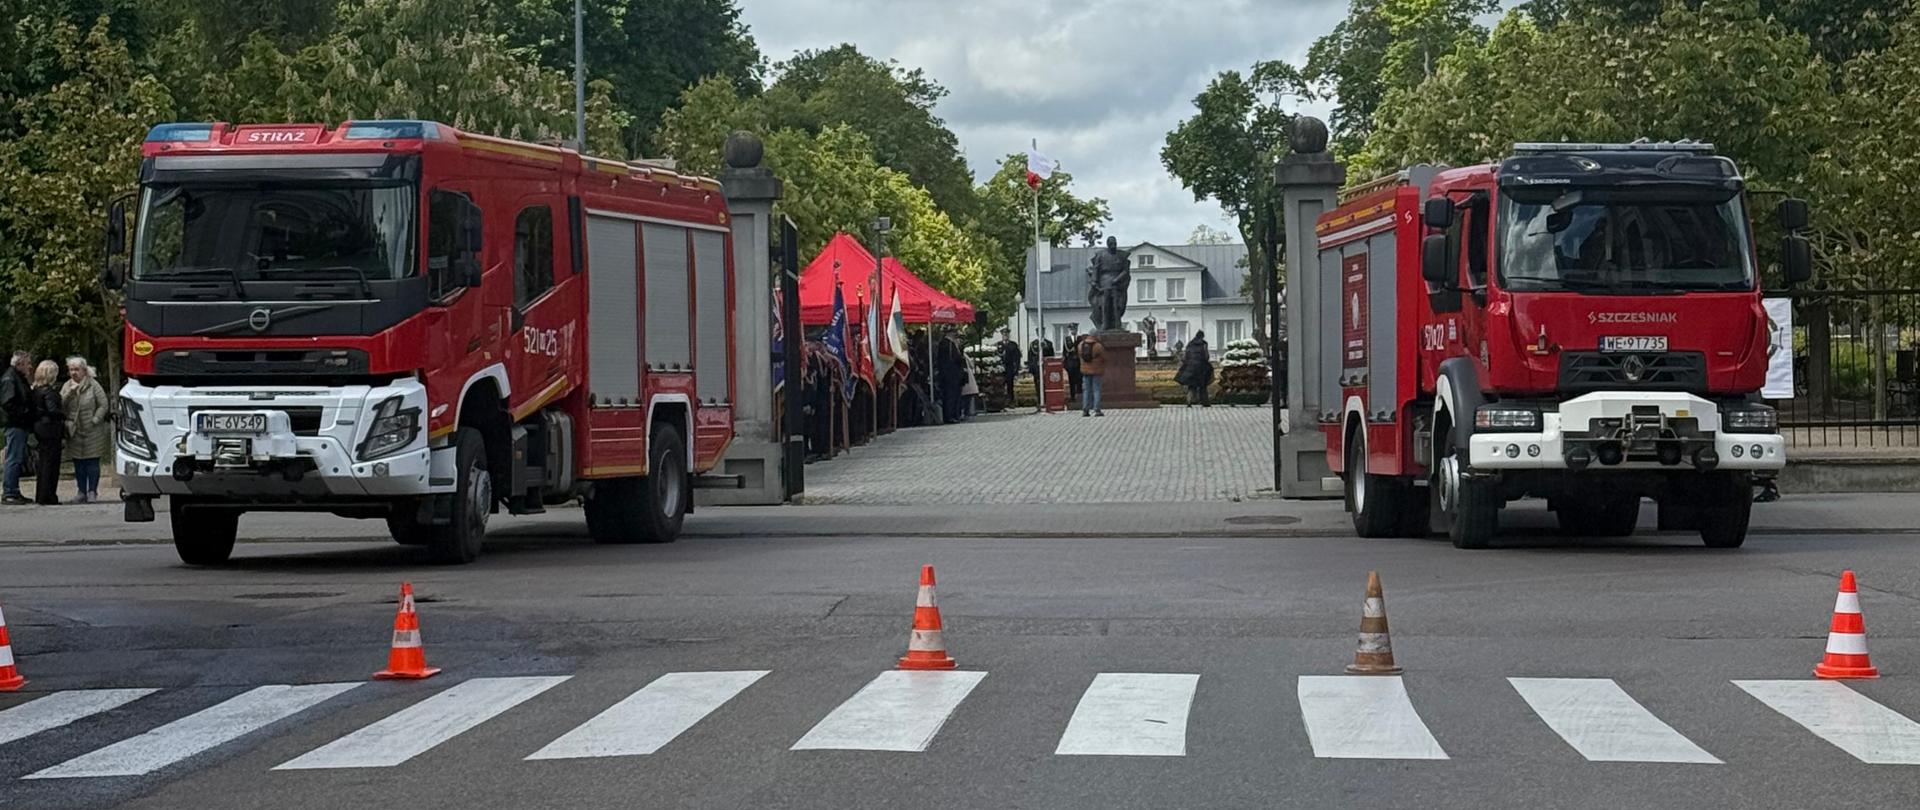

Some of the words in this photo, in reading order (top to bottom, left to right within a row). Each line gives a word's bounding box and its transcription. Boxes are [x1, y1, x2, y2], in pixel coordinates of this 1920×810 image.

[524, 326, 539, 354] 521
[546, 329, 557, 356] 25
[1607, 337, 1623, 349] WE
[206, 415, 221, 429] WE
[225, 415, 262, 429] 6V549
